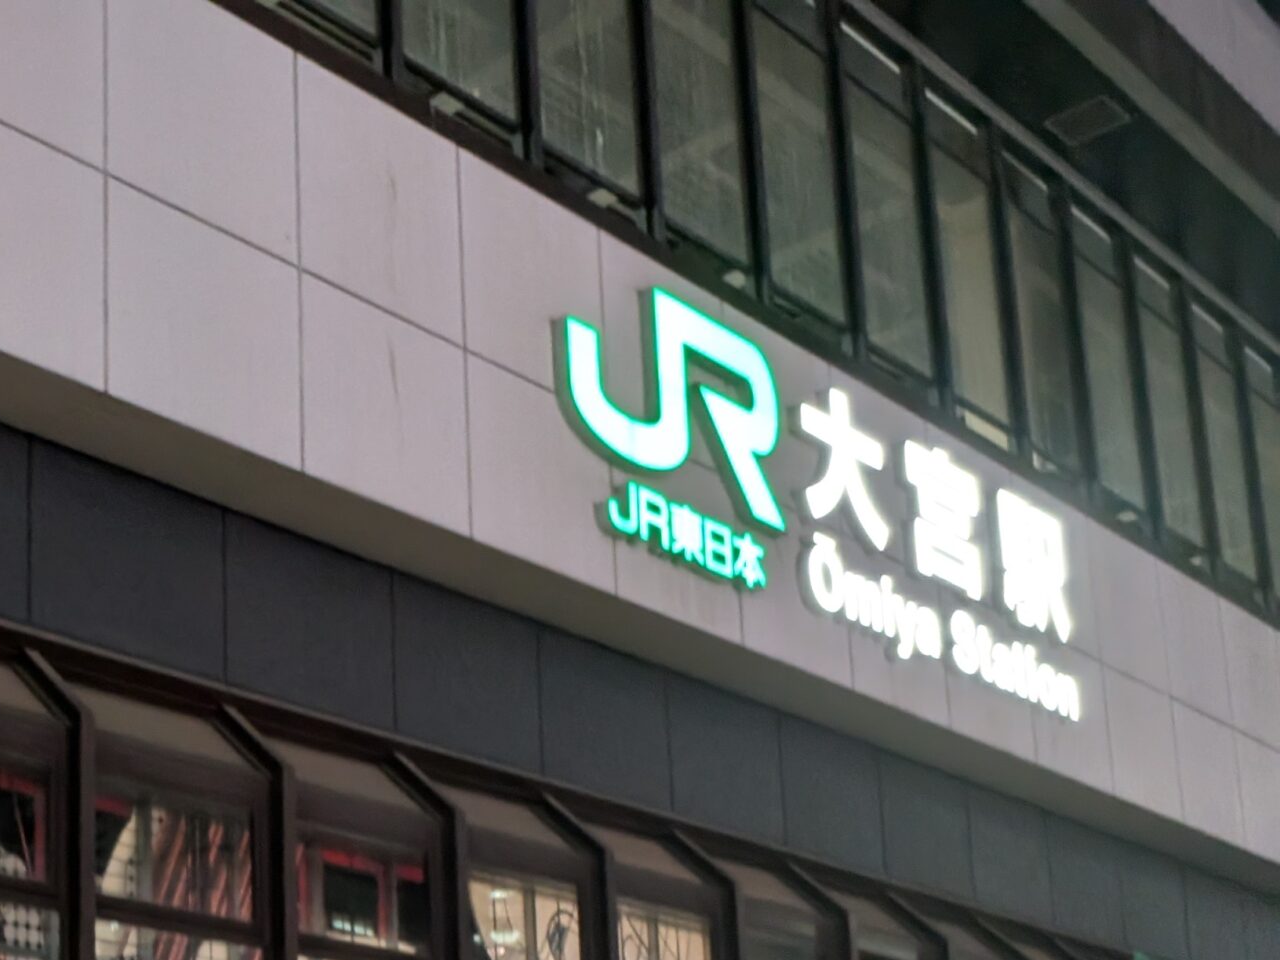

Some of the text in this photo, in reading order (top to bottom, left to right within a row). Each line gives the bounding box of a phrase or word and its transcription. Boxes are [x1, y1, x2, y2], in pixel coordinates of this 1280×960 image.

[562, 286, 787, 532] JR
[607, 480, 767, 591] JR東日本
[799, 386, 1072, 644] 大宮駅
[949, 608, 1081, 723] Station
